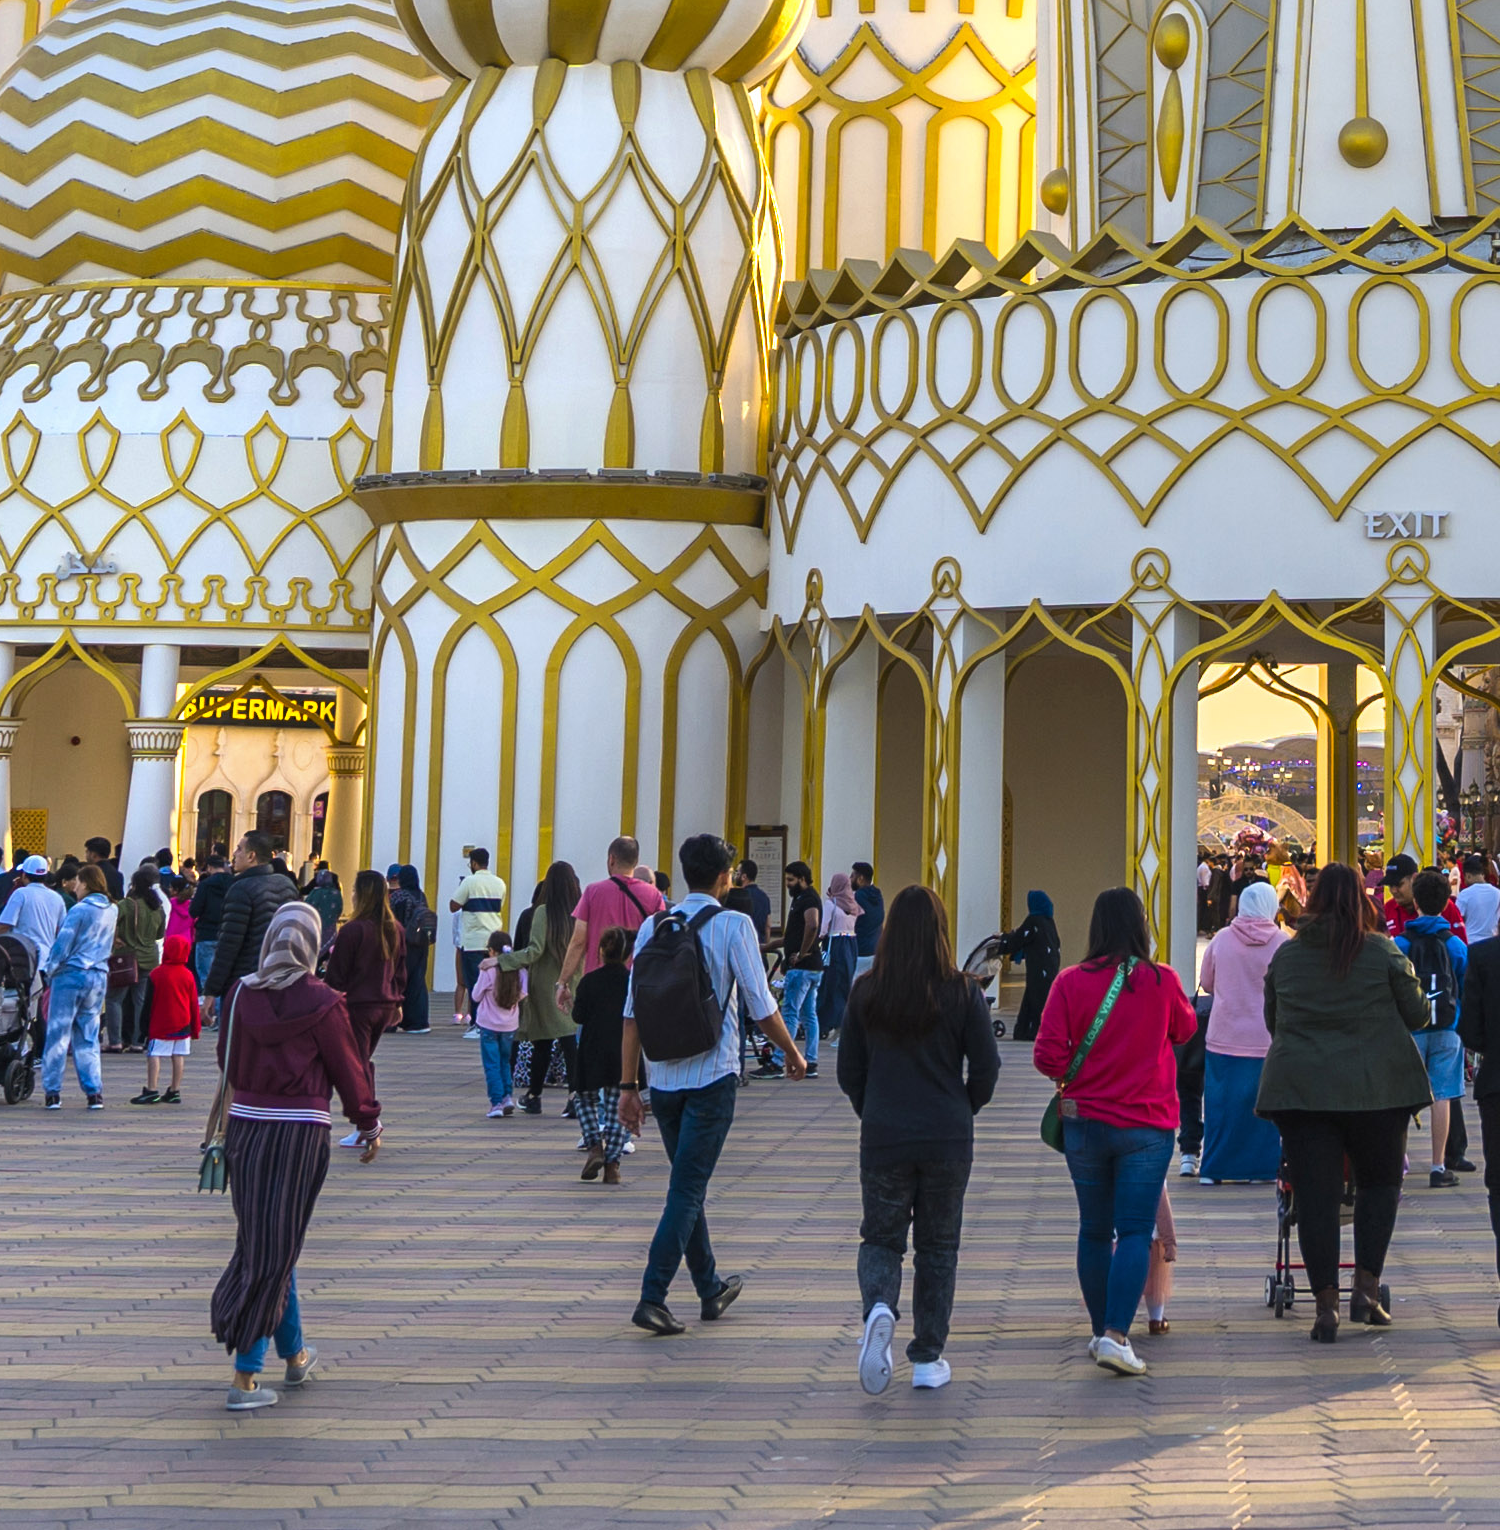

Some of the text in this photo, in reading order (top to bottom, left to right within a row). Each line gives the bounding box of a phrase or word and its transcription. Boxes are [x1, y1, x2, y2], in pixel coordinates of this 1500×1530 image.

[1364, 511, 1449, 539] EXIT
[1085, 969, 1125, 1046] LOUIS VUITTON
